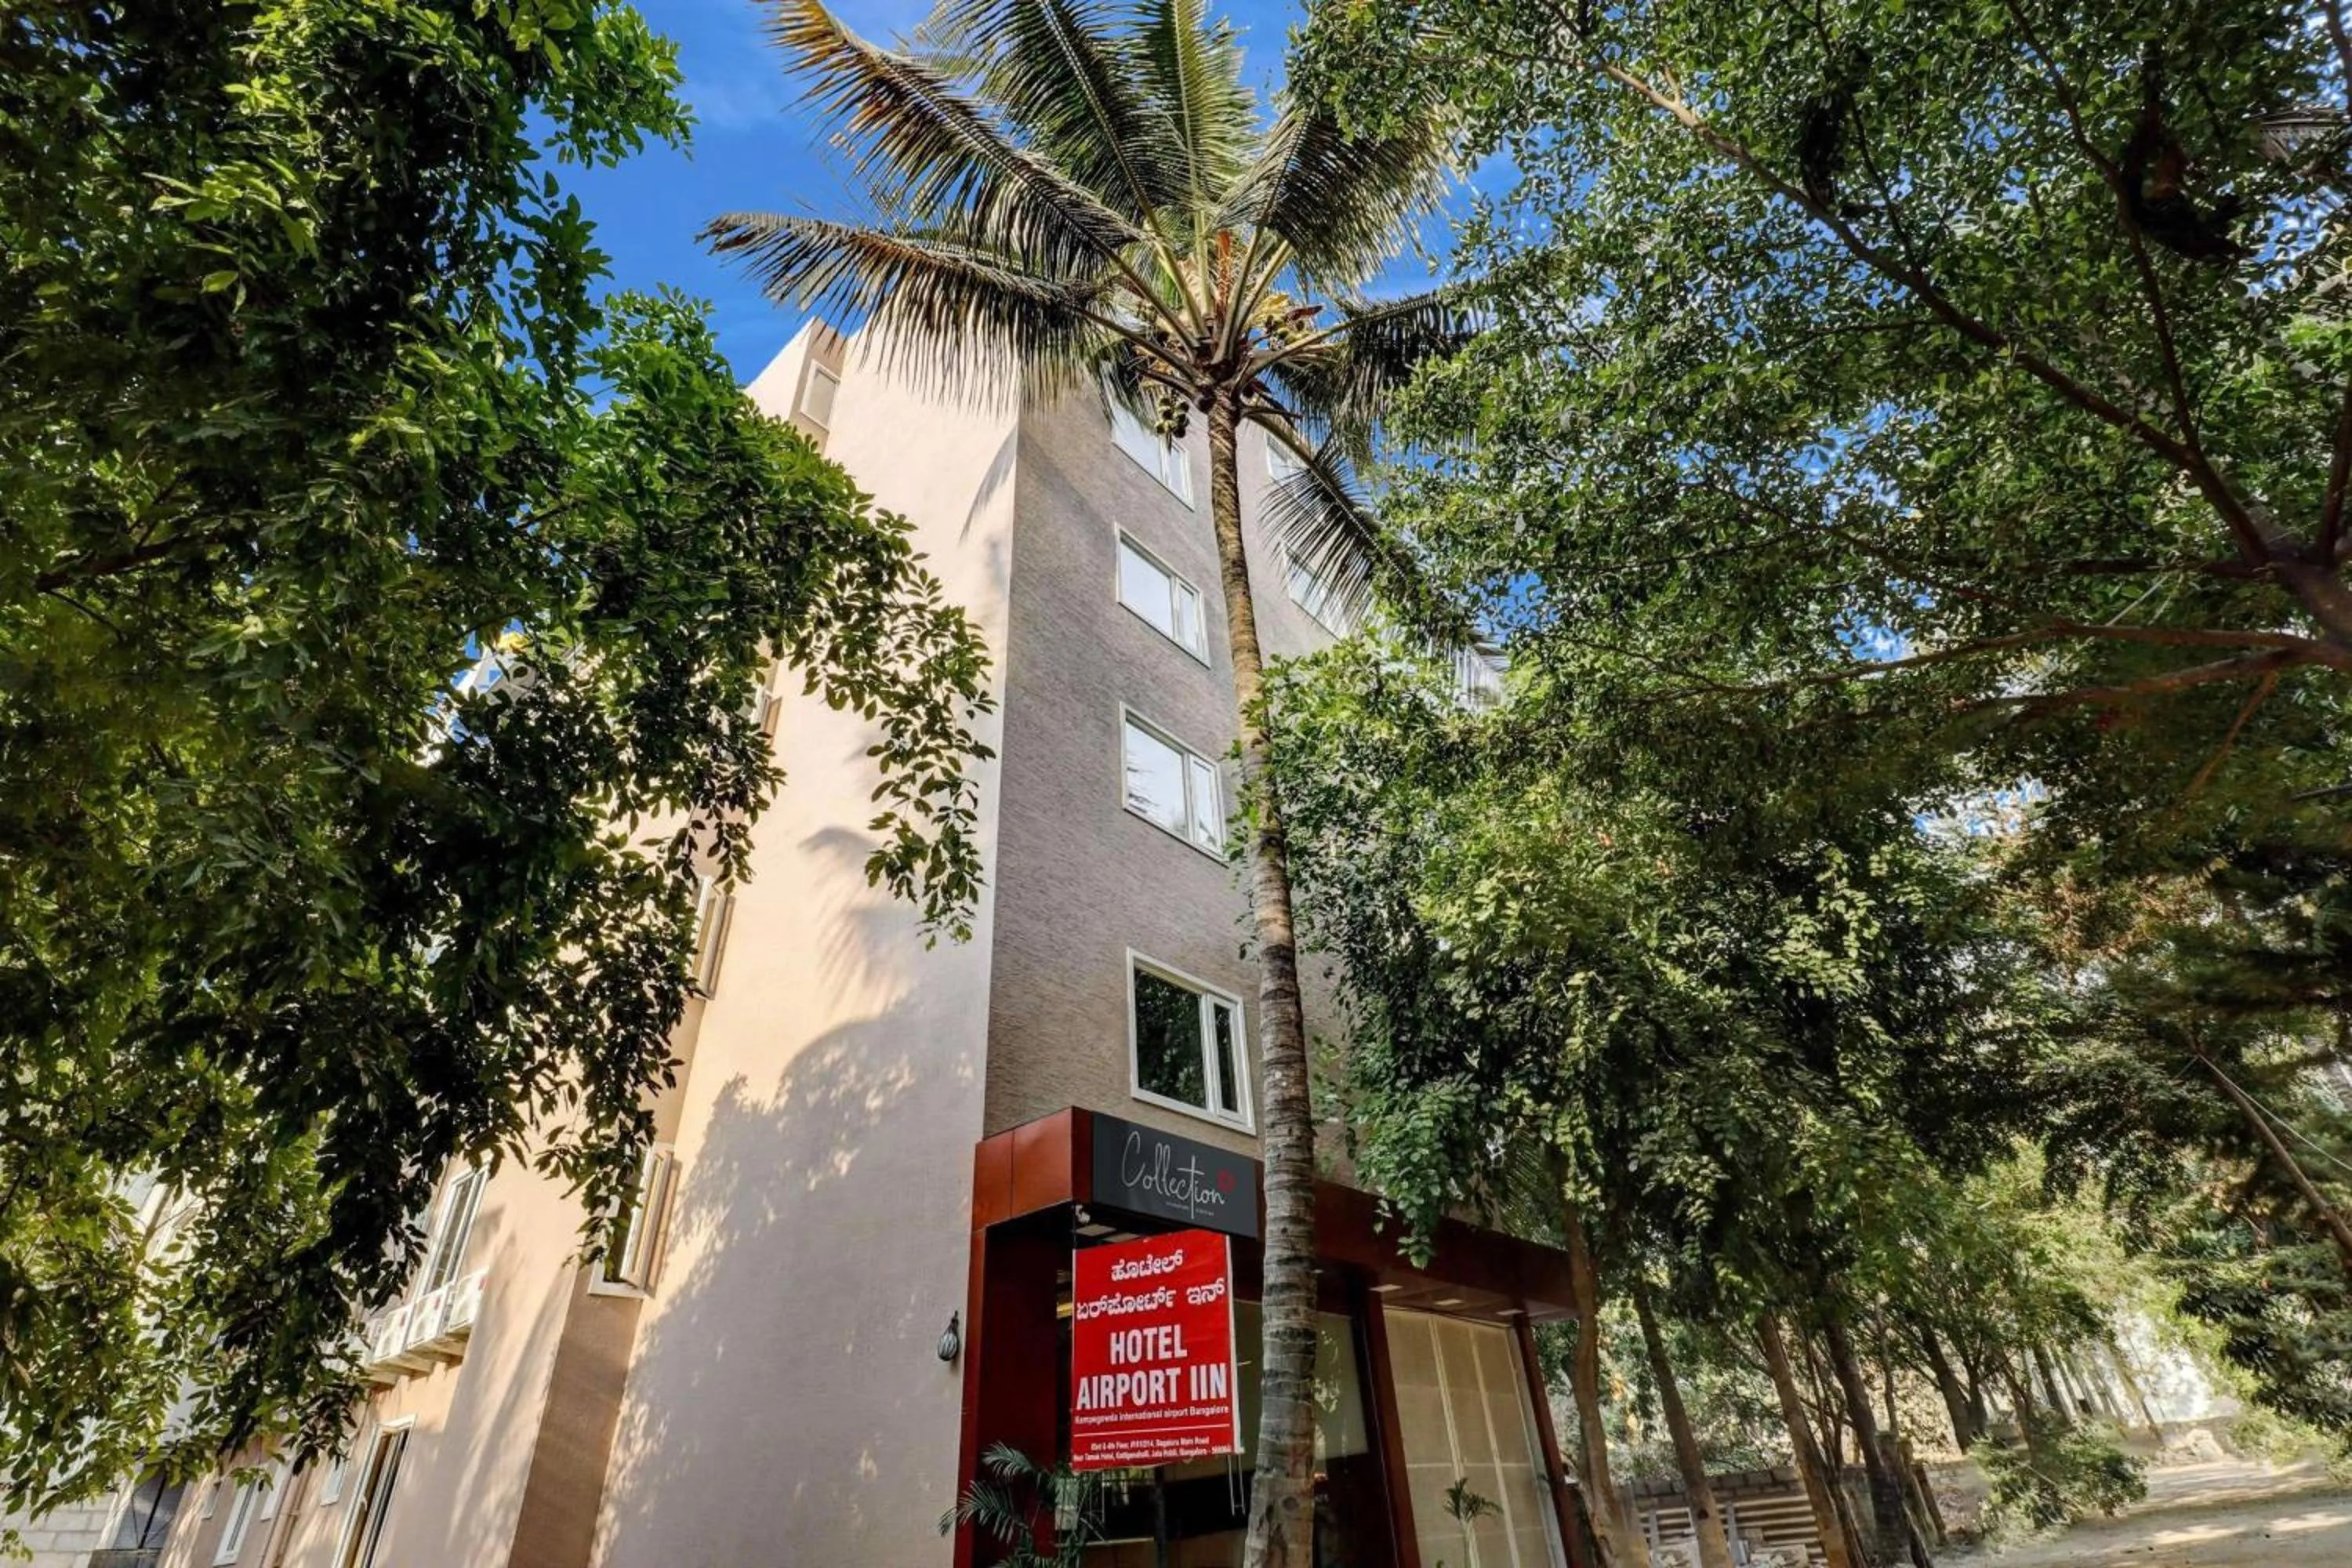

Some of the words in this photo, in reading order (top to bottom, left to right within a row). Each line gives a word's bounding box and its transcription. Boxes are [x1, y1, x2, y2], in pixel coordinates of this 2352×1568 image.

[1121, 1131, 1225, 1220] Collection
[1110, 1324, 1188, 1365] HOTEL
[1076, 1367, 1181, 1410] AIRPORT
[1163, 1407, 1189, 1418] airport
[1189, 1405, 1229, 1417] Bangalore
